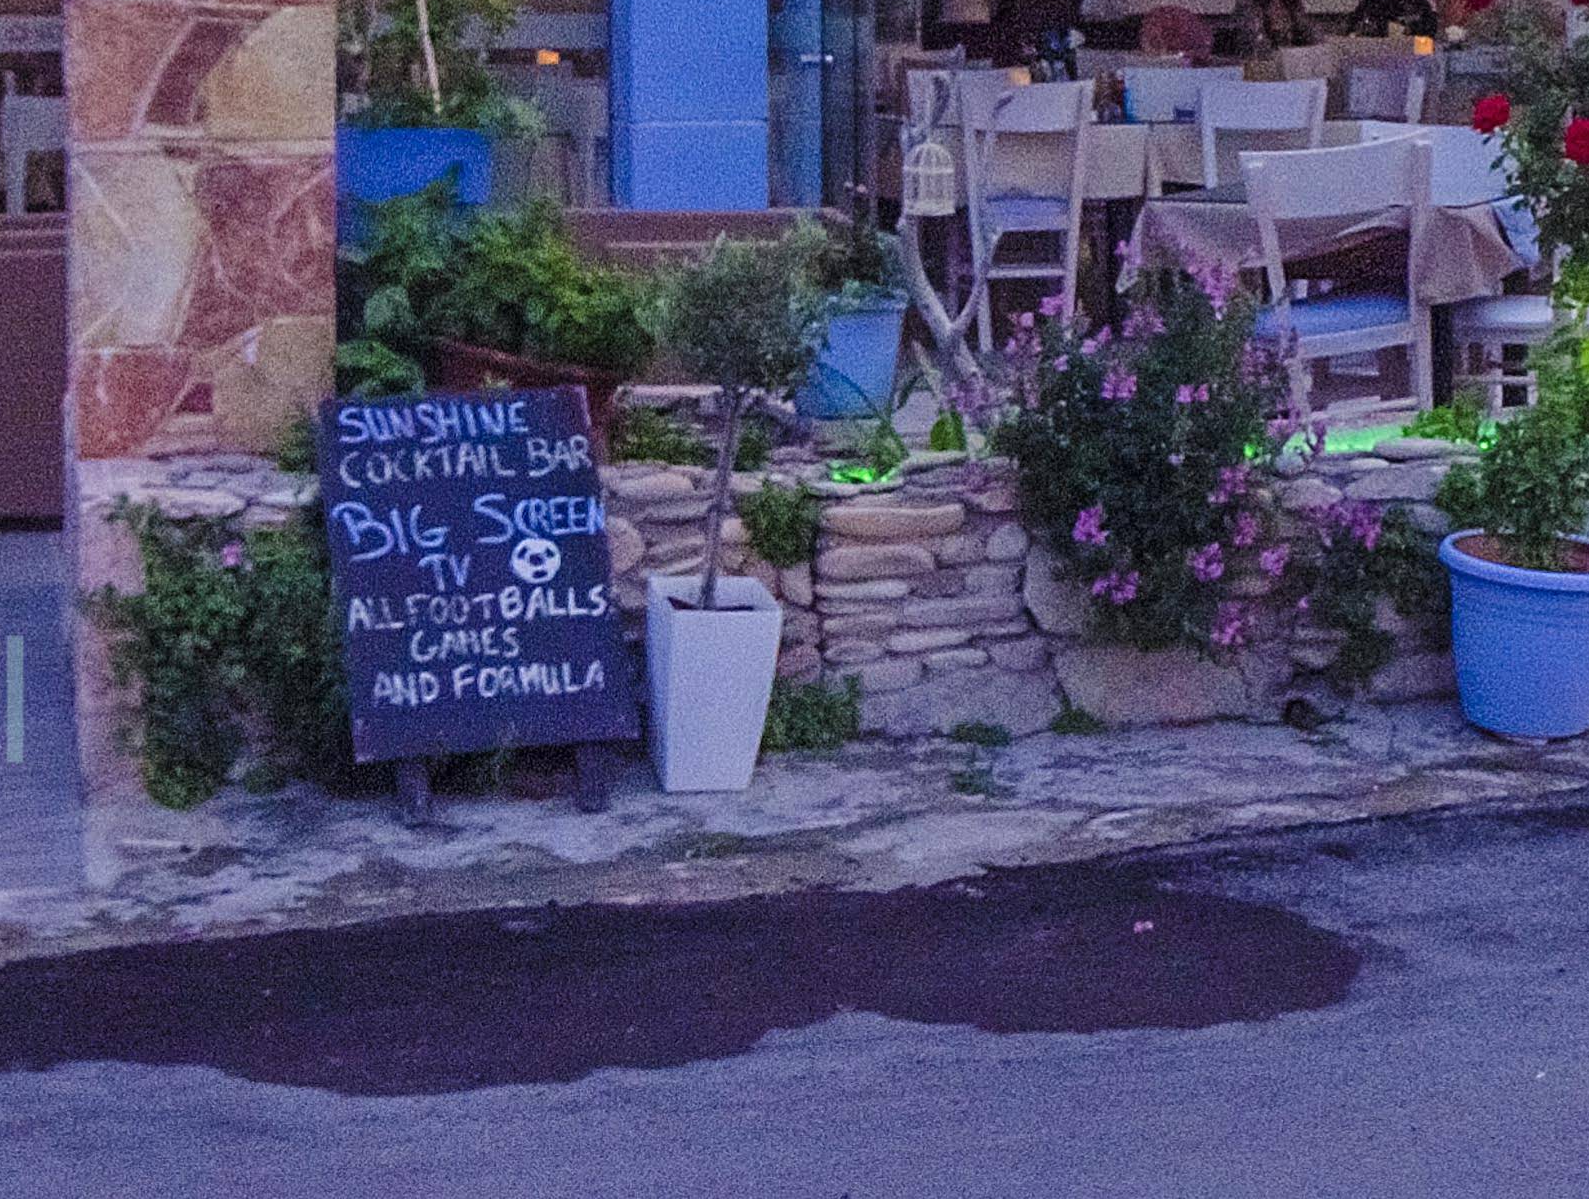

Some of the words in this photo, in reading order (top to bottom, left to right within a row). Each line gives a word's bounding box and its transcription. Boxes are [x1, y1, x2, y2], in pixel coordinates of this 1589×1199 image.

[338, 400, 529, 443] SUNSHINE
[339, 441, 517, 489] COCKTAIL
[526, 435, 593, 478] BAR
[331, 500, 451, 563] BIG
[473, 492, 607, 544] SCREEN
[417, 552, 473, 592] TV
[411, 625, 521, 664] GAMES
[371, 670, 441, 707] AND
[451, 658, 607, 701] FORMULA
